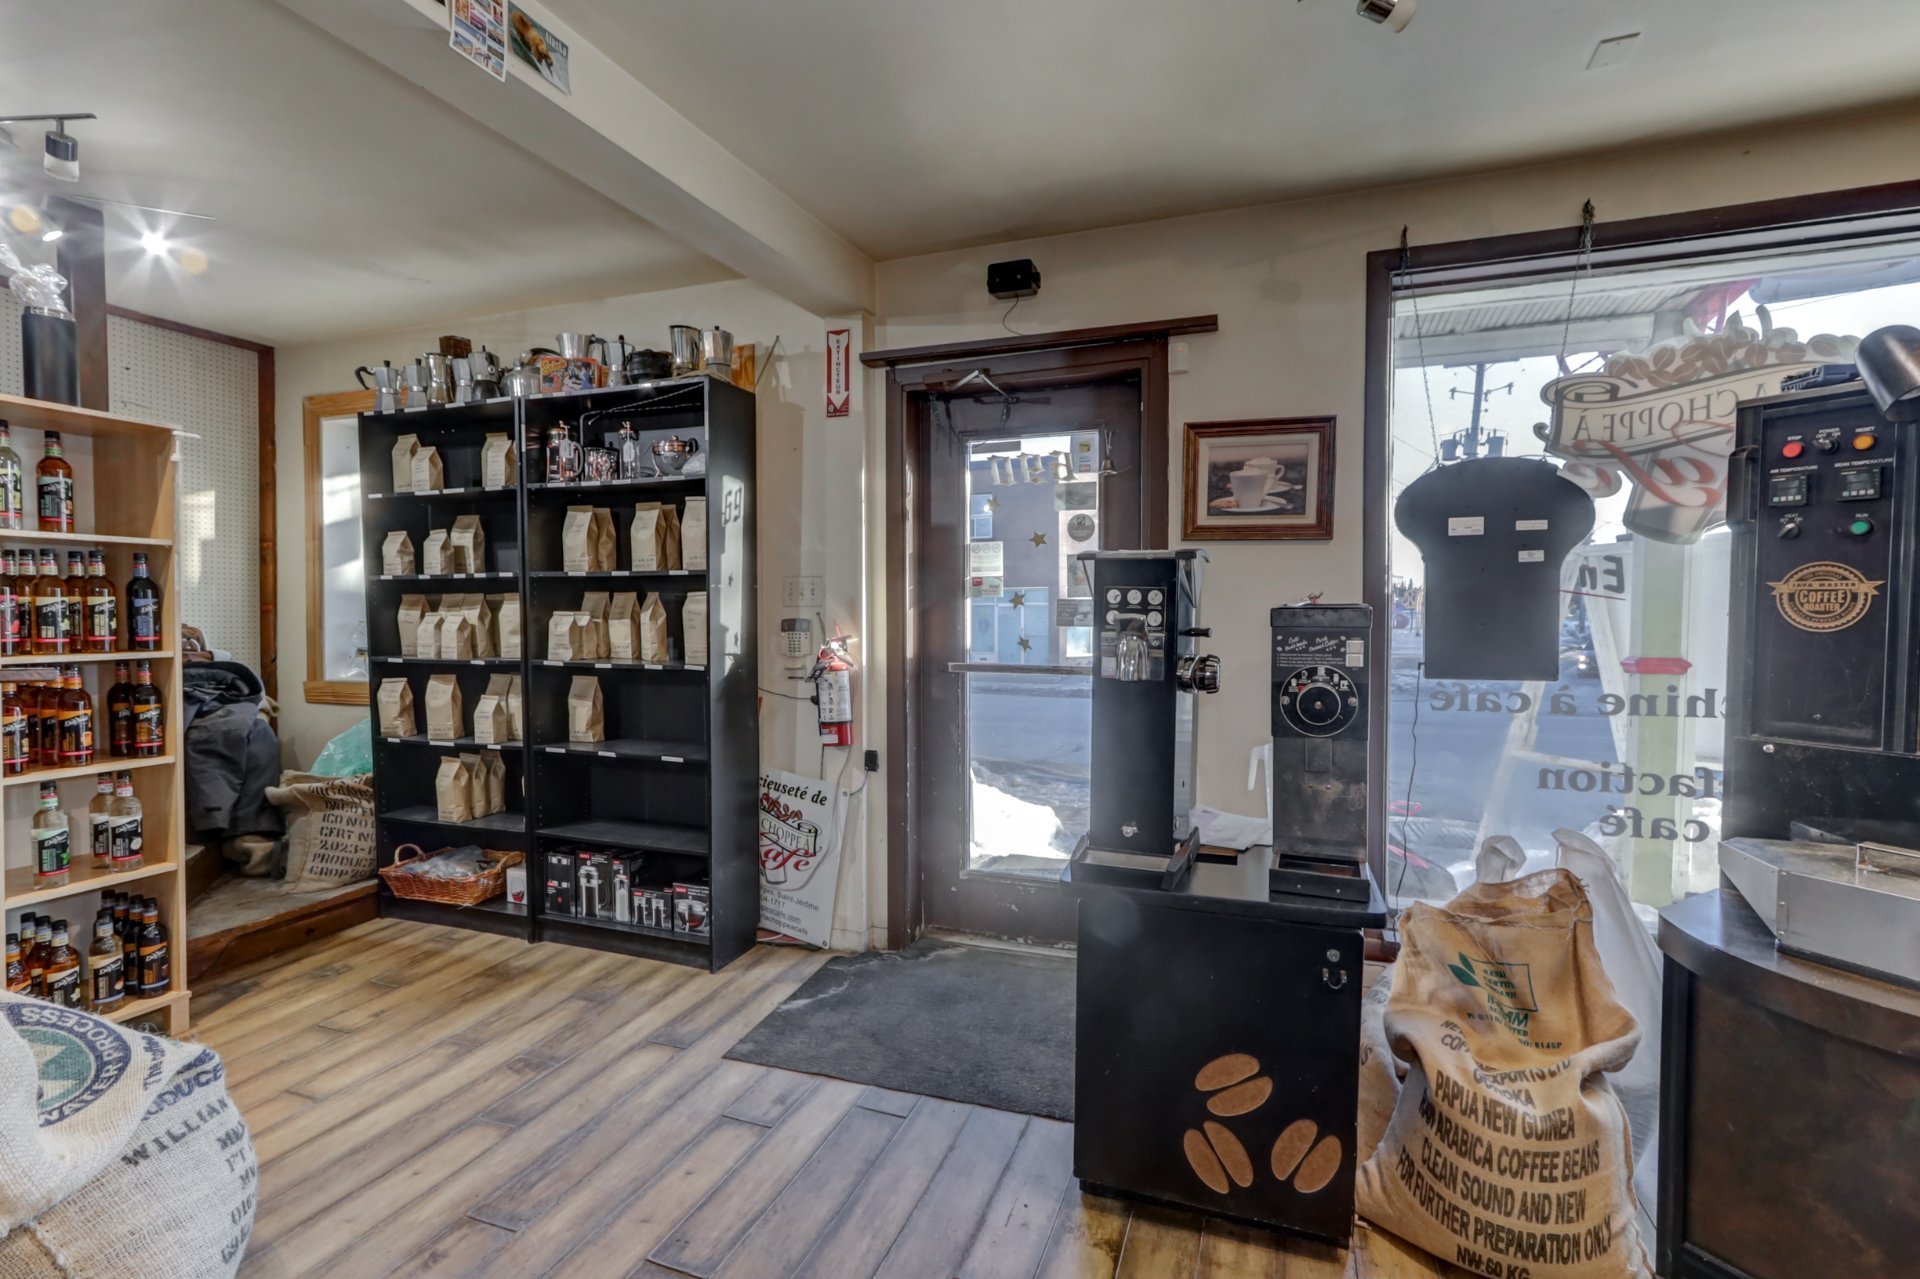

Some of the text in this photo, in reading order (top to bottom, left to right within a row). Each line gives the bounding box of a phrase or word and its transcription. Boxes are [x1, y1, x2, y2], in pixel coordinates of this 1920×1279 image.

[1779, 464, 1819, 473] TEMPERATURE
[1850, 457, 1894, 466] TEMPERATURE
[1799, 590, 1846, 603] COFFEE
[1803, 602, 1841, 612] ROASTER
[811, 790, 827, 806] de
[346, 817, 368, 828] NO
[320, 826, 355, 840] CERT
[761, 819, 802, 850] CHOPPE
[312, 853, 377, 868] PRODUCT
[309, 865, 349, 879] CROP
[19, 1006, 127, 1062] PROCESS
[1435, 1069, 1574, 1142] PAPUA NEW GUINEA
[1434, 1109, 1494, 1173] ARABICA
[1496, 1145, 1560, 1183] COFFEE
[1561, 1139, 1600, 1183] BEANS
[1420, 1136, 1586, 1225] CLEAN SOUND AND NEW
[1396, 1145, 1612, 1266] FOR FURTHER PREPARATION ONLY
